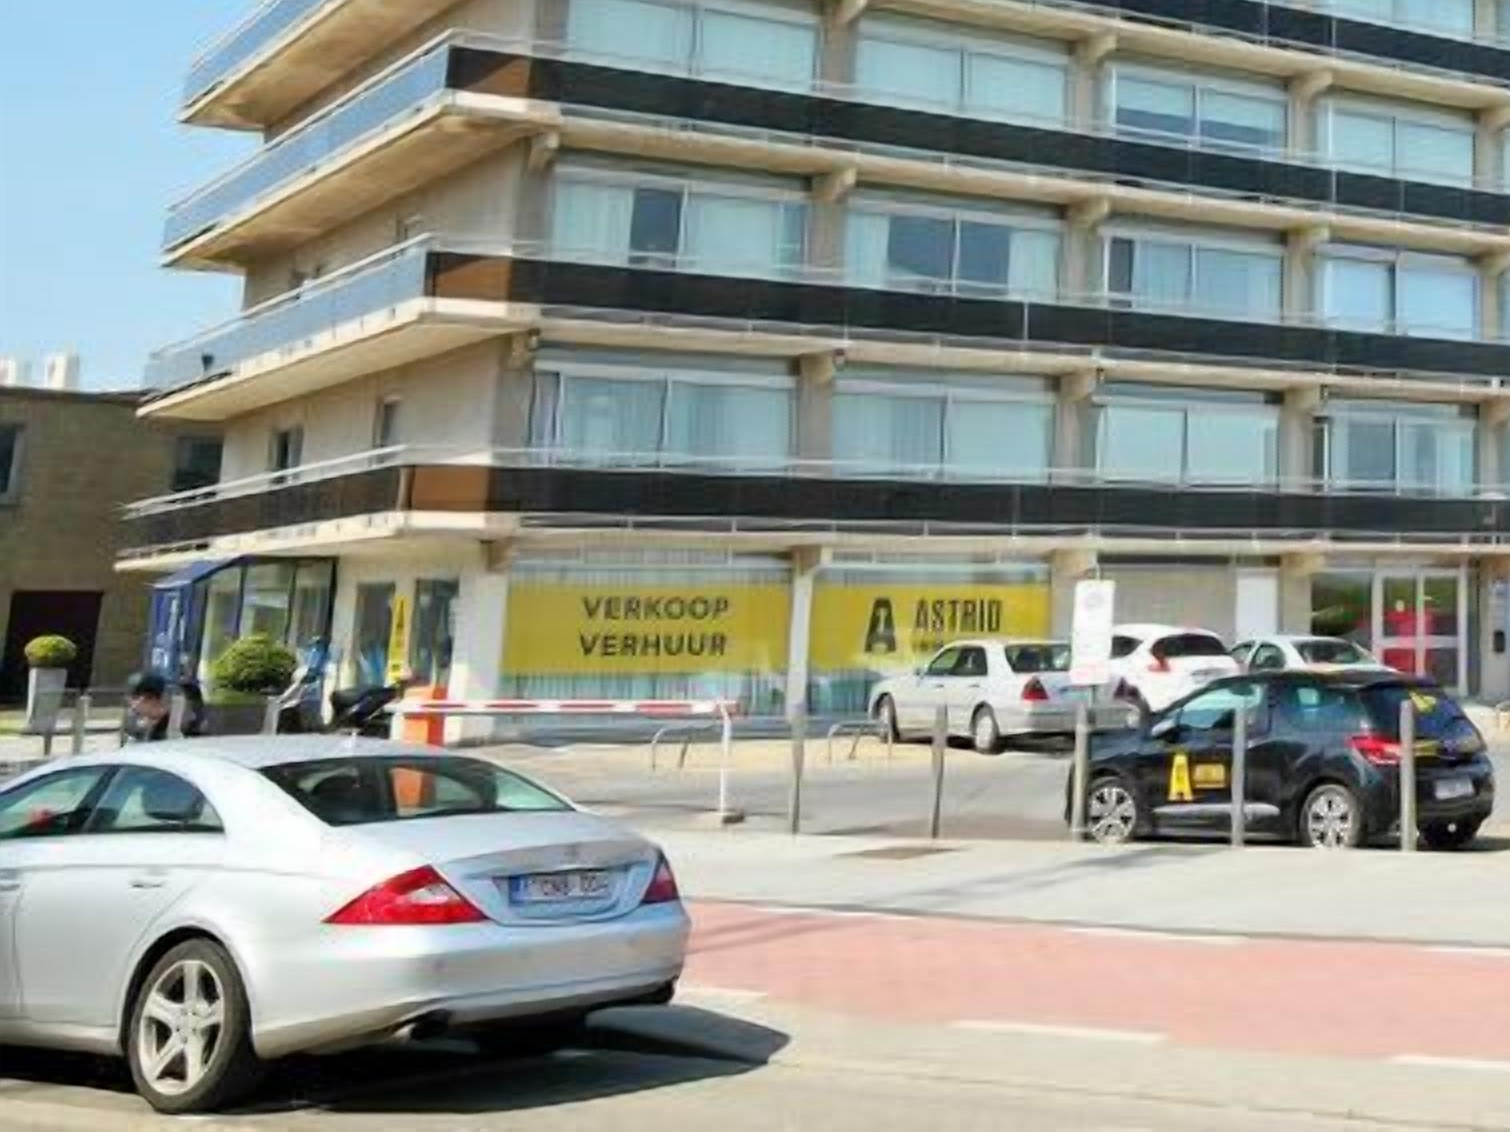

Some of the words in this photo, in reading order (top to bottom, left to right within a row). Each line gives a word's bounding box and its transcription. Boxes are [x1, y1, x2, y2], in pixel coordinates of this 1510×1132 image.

[582, 595, 729, 620] VERKOOP
[864, 597, 896, 653] A
[916, 598, 1002, 633] ASTRID
[579, 631, 727, 656] VERHUUR
